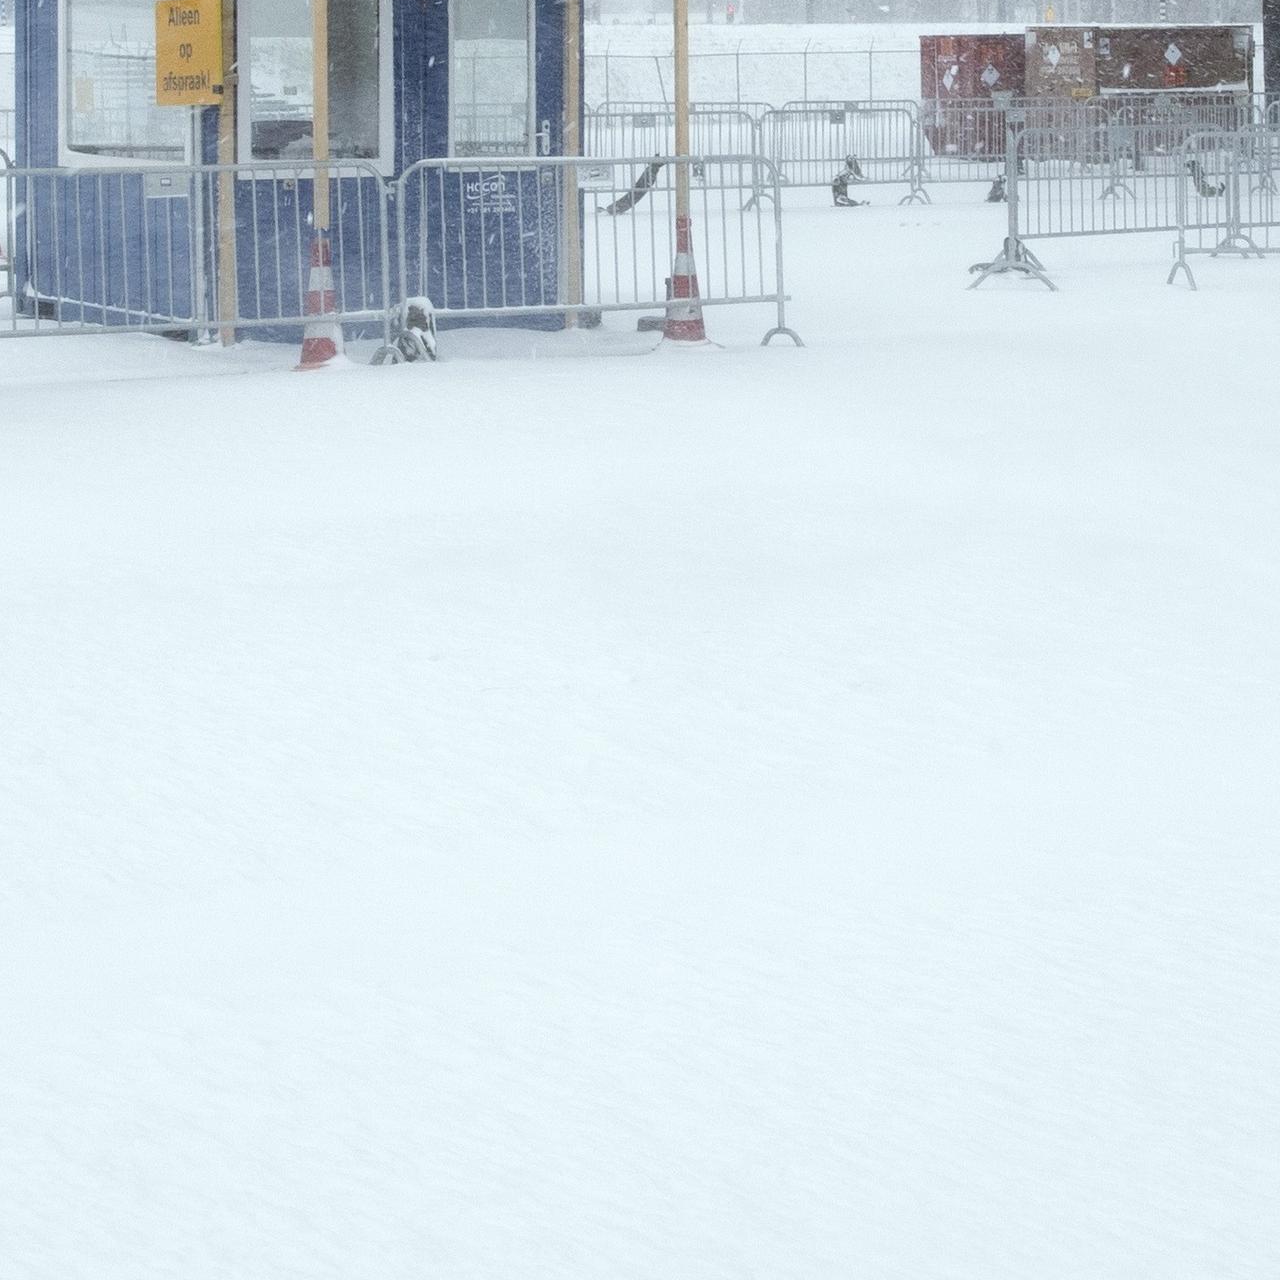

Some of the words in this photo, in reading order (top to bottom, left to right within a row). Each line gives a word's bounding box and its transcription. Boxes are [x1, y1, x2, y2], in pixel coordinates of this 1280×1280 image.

[168, 6, 200, 26] Alleen
[179, 42, 193, 61] op
[163, 70, 210, 96] afspraak!
